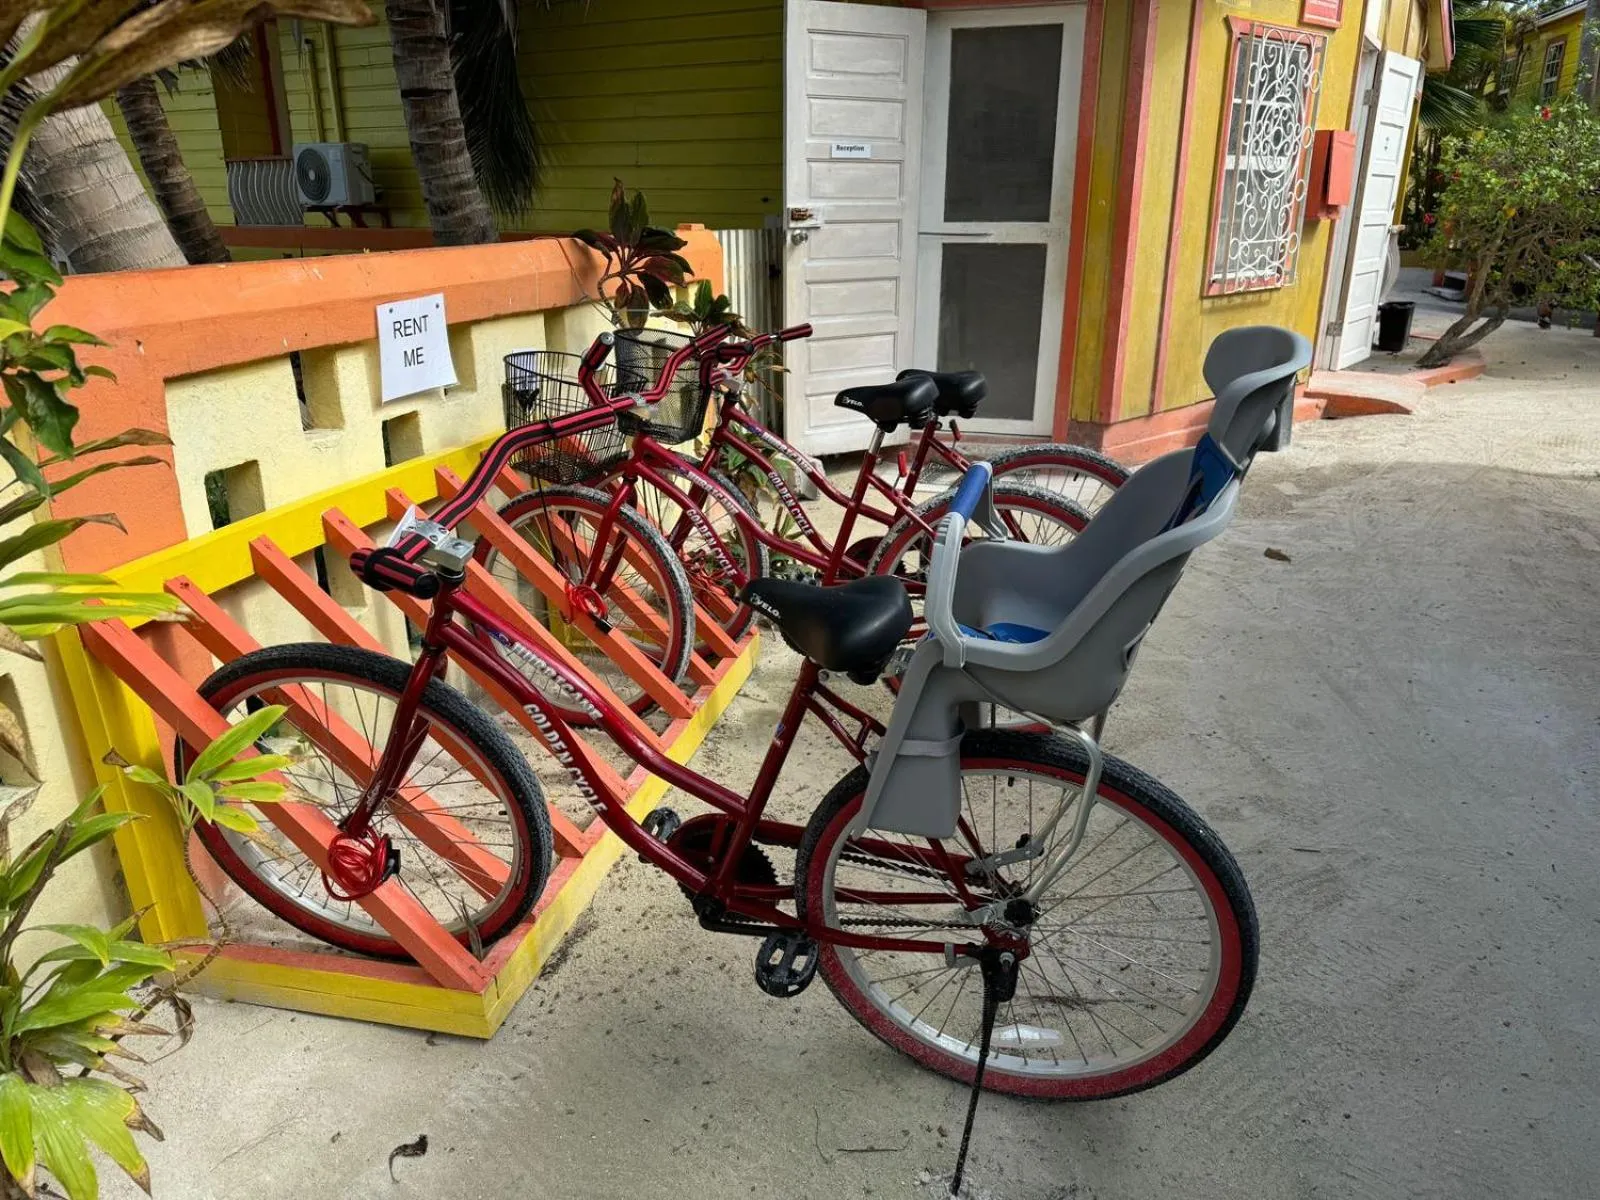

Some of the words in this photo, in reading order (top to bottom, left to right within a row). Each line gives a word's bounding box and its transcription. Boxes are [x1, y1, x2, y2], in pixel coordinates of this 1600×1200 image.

[836, 144, 865, 152] Reception
[393, 315, 429, 339] RENT
[403, 346, 425, 367] ME
[768, 471, 796, 507] GOLDEN
[791, 507, 814, 536] CYCLE
[686, 509, 717, 545] GOLDEN
[714, 547, 737, 577] CYCLE
[757, 598, 780, 617] VELO
[523, 703, 574, 764] GOLDEN
[568, 767, 608, 812] CYCLE
